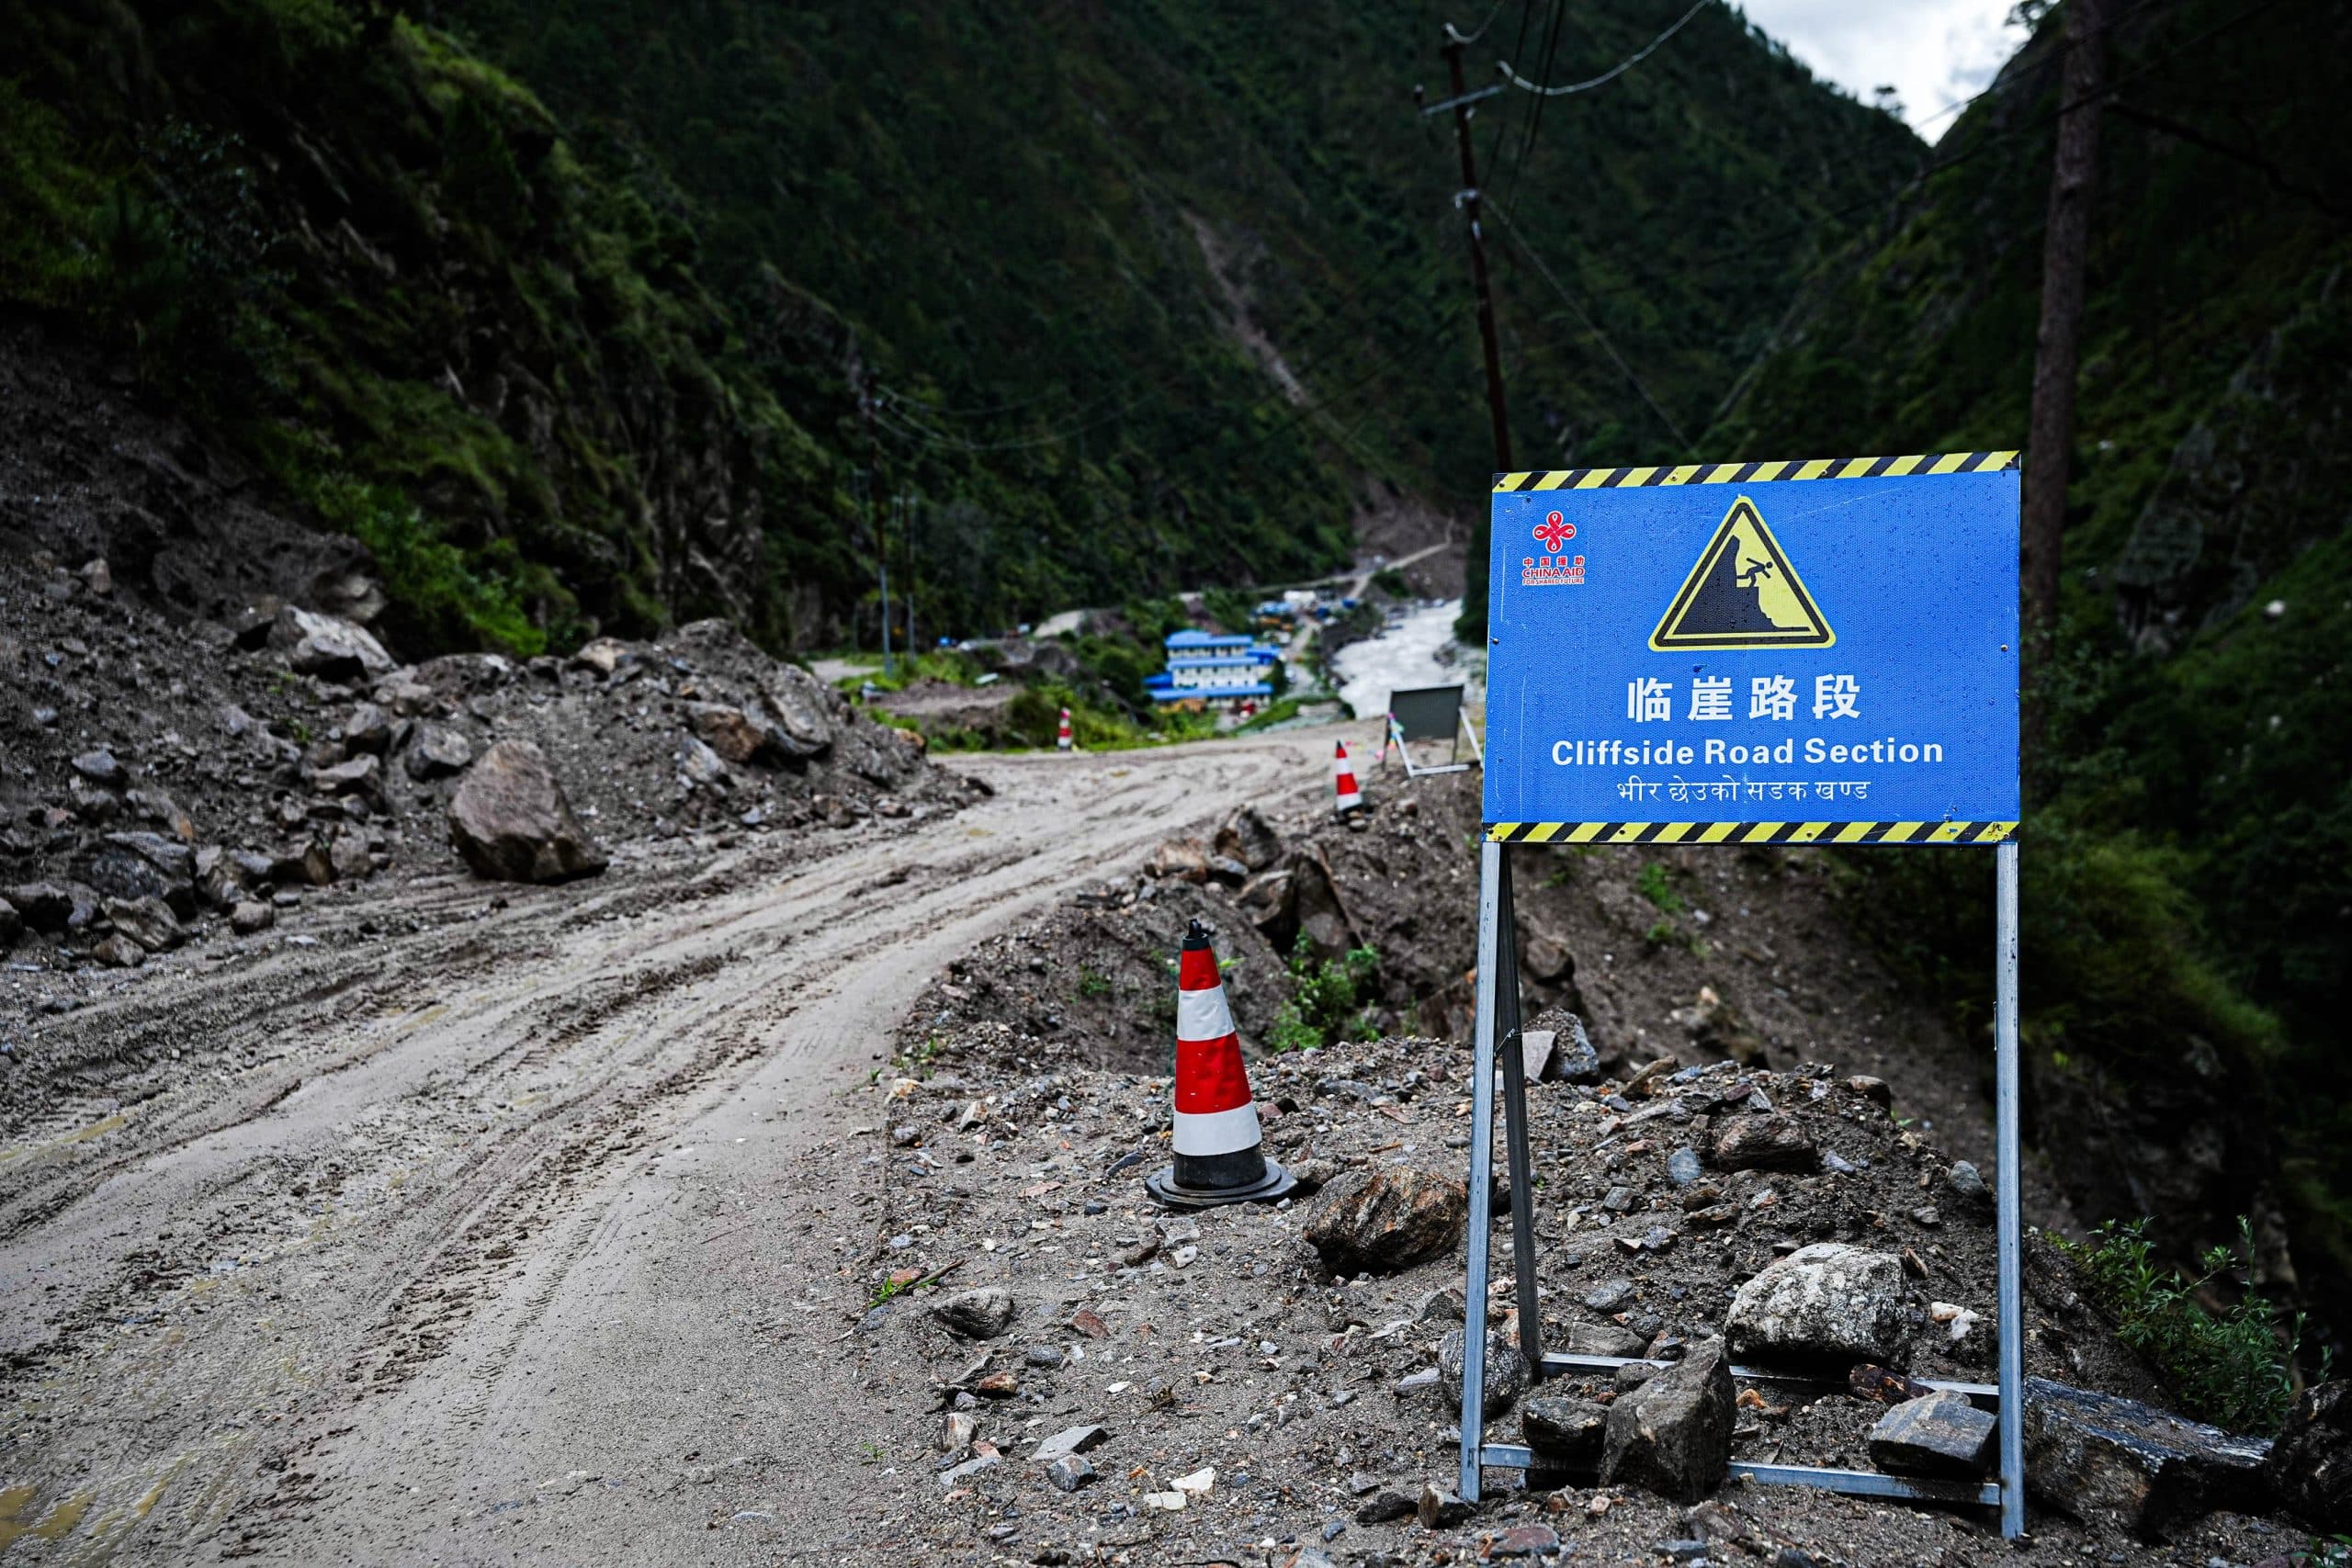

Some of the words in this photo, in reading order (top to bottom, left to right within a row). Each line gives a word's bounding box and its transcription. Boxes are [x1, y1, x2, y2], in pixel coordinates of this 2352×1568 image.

[1522, 567, 1560, 578] CHINA
[1562, 567, 1585, 577] AID
[1627, 674, 1861, 722] 临崖路段
[1551, 739, 1694, 766] Cliffside
[1704, 738, 1793, 765] Road
[1804, 737, 1943, 764] Section
[1616, 775, 1663, 801] भीर
[1668, 774, 1741, 803] छेउको
[1747, 781, 1809, 801] सडक
[1815, 781, 1871, 800] खण्ड
